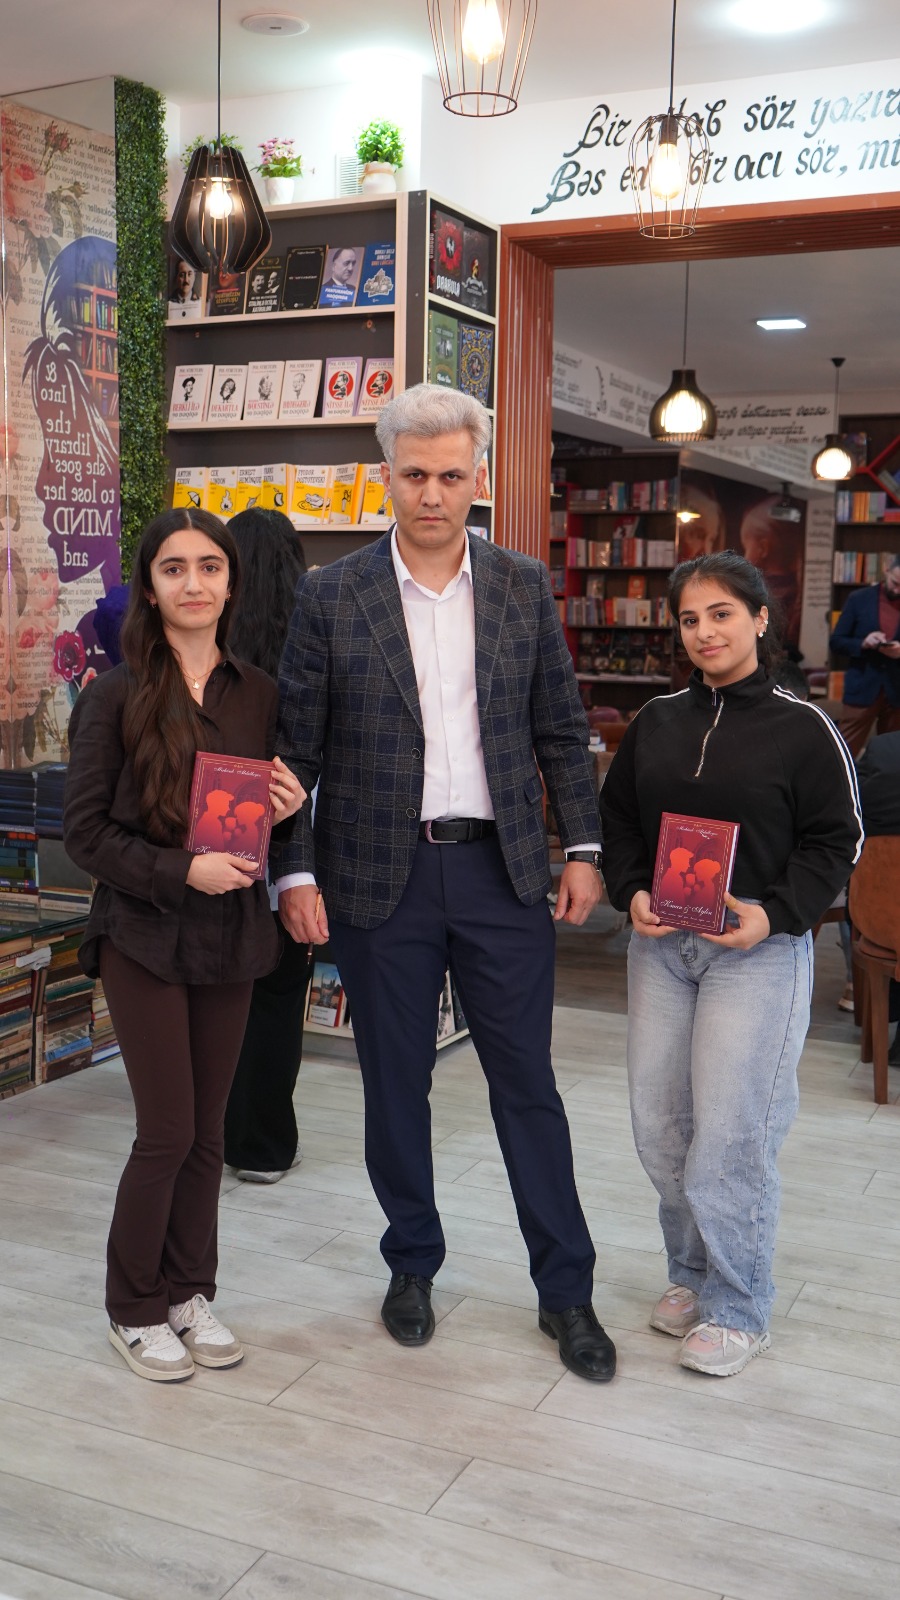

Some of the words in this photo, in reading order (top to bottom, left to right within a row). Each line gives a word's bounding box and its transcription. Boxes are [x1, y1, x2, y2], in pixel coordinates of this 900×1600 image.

[744, 95, 796, 132] söz
[531, 160, 606, 214] Bəs
[734, 151, 785, 182] acı
[177, 470, 191, 478] ANTON
[210, 477, 226, 485] LONDON
